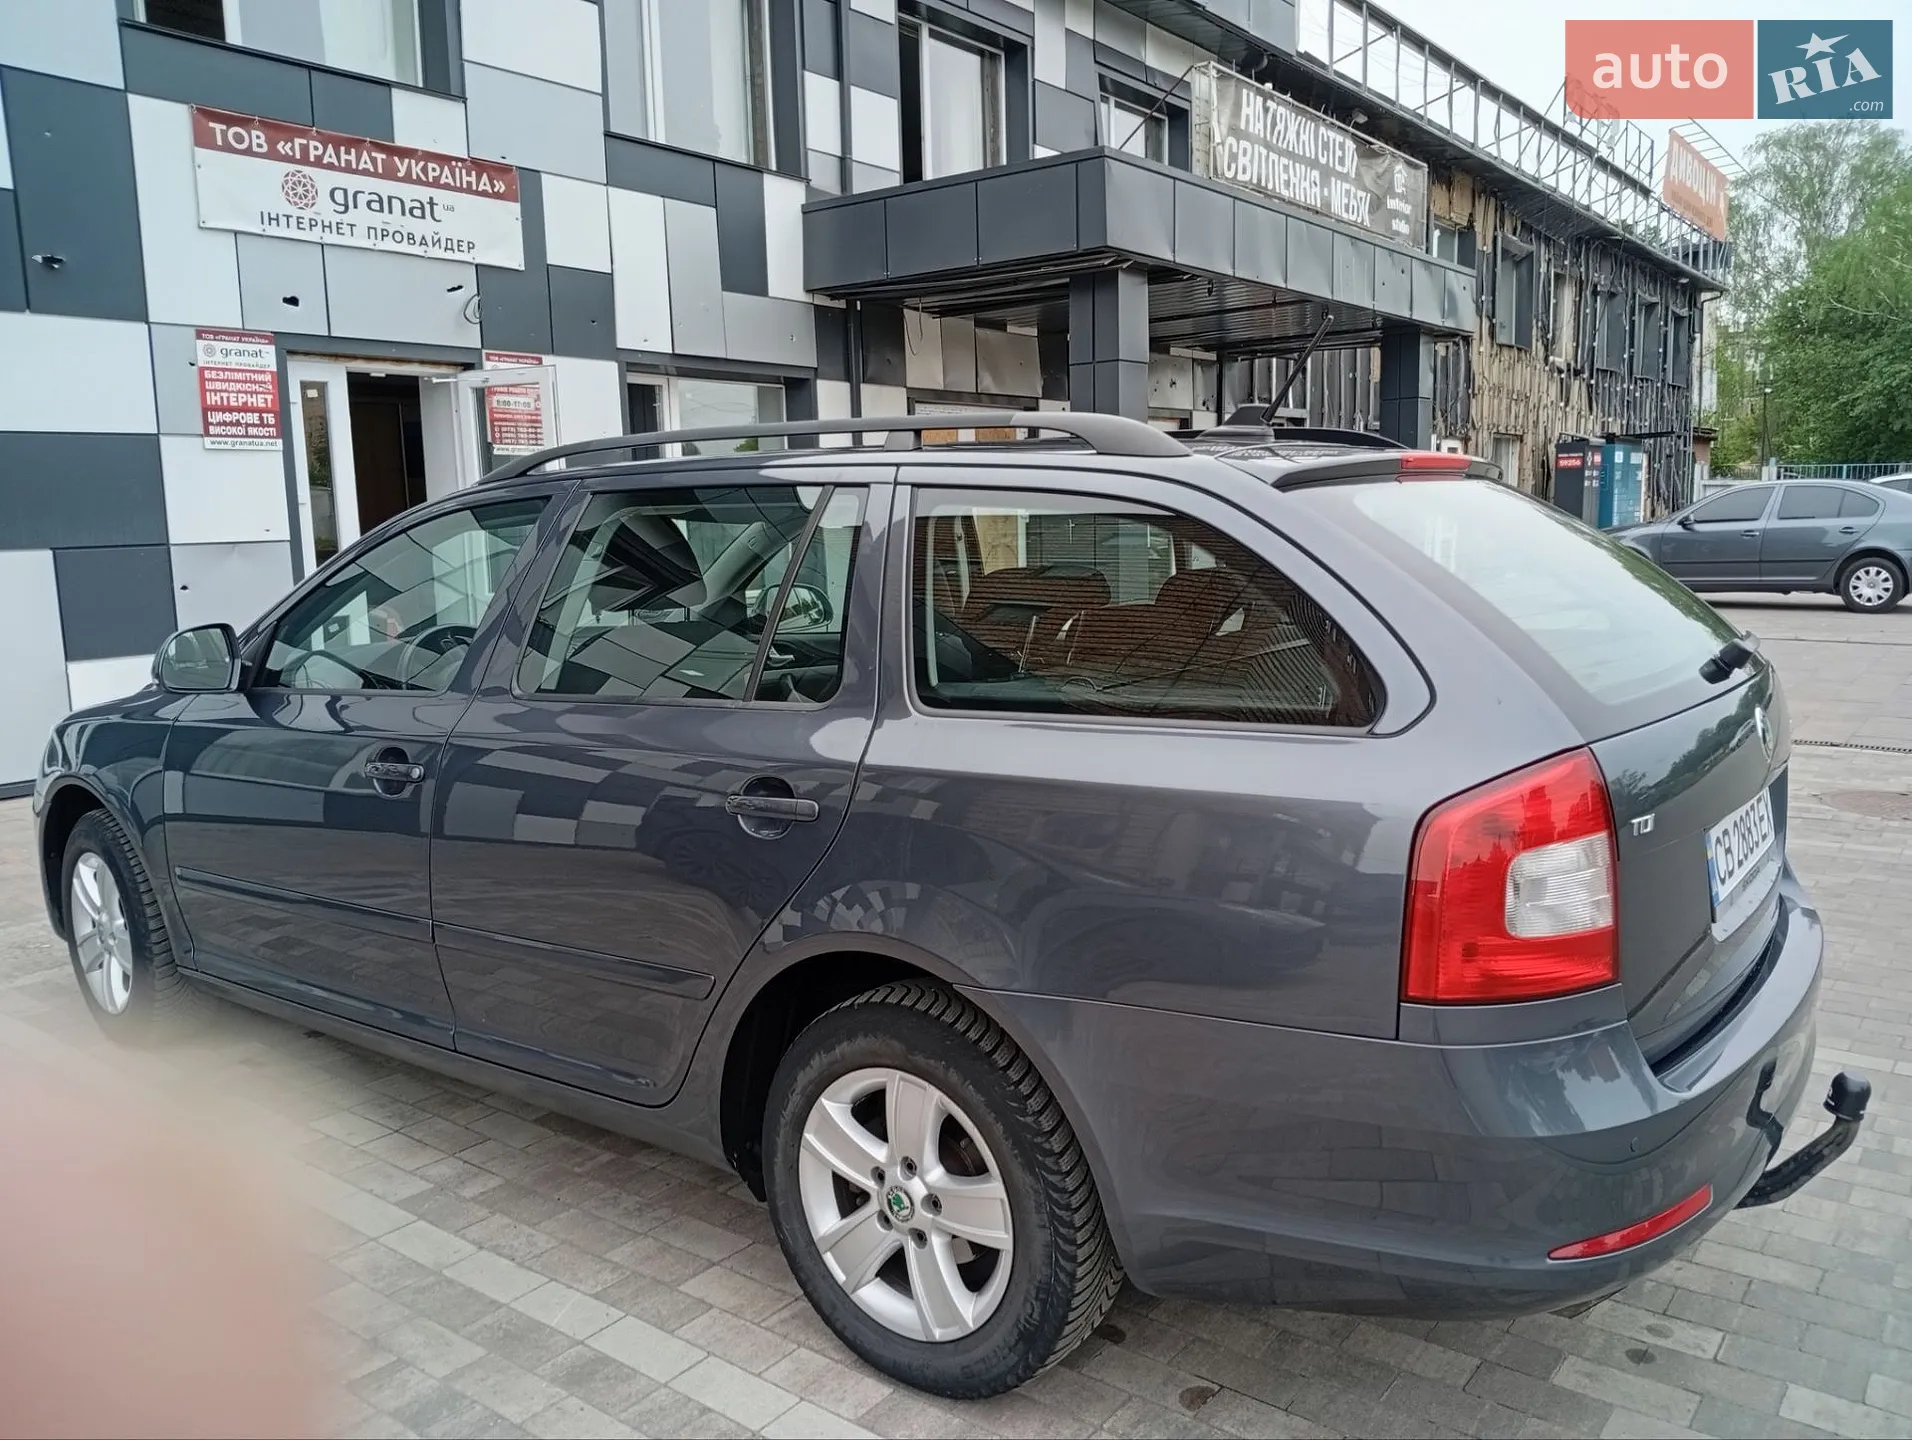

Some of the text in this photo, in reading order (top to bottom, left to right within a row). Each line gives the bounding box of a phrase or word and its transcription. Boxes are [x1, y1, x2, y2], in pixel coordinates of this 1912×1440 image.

[1240, 88, 1315, 160] НАТЯЖНІ
[208, 121, 506, 194] ТОВ «ГРАНАТ УКРАЇНА»
[1223, 136, 1321, 208] СВІТЛЕННЯ
[330, 185, 443, 223] granat
[260, 210, 476, 254] ІНТЕРНЕТ ПРОВАЙДЕР
[220, 347, 264, 358] granat
[204, 370, 272, 382] БЕЗЛІМІТНИЙ
[206, 391, 273, 408] ІНТЕРНЕТ
[208, 411, 275, 424] ЦИФРОВЕ ТБ
[209, 425, 277, 437] ВИСОКОЇ ЯКОСТІ
[1715, 828, 1734, 886] CB
